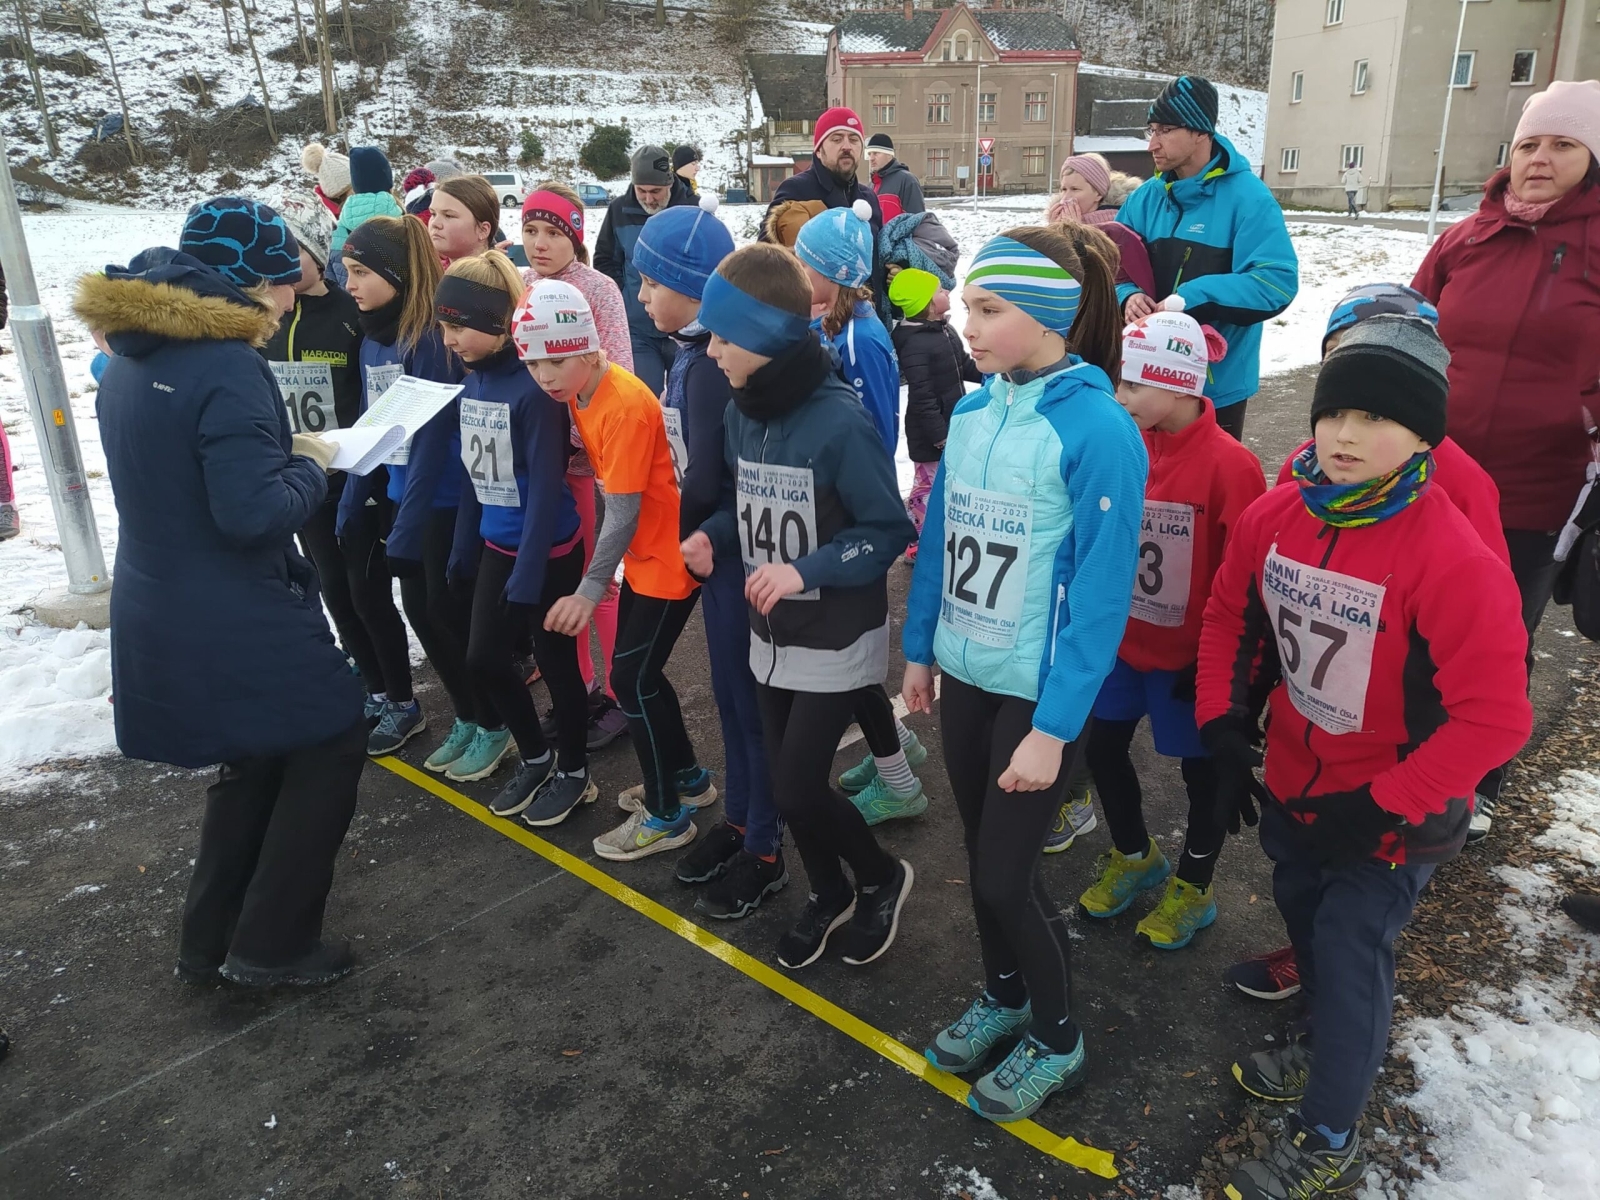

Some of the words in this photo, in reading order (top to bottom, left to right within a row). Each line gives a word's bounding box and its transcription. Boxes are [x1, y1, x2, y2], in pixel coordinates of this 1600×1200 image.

[539, 293, 569, 301] FROLEN
[555, 312, 578, 324] LES
[1156, 318, 1190, 329] FROLEN
[544, 336, 590, 350] MARATON
[1166, 338, 1193, 356] LES
[301, 349, 348, 360] MARATON
[304, 376, 328, 386] LIGA
[1142, 363, 1199, 383] MARATON
[285, 390, 326, 434] 16
[461, 414, 486, 428] BĚŽECKÁ
[490, 420, 508, 430] LIGA
[470, 434, 499, 482] 21
[738, 480, 777, 499] BĚŽECKÁ
[781, 488, 809, 502] LIGA
[947, 507, 985, 529] ĚŽECKÁ
[991, 517, 1026, 536] LIGA
[1159, 523, 1190, 537] LIGA
[741, 502, 809, 564] 140
[947, 531, 1018, 610] 127
[1312, 576, 1330, 586] KRÁLE
[1331, 580, 1364, 595] JESTŘEBÍCH
[1365, 590, 1378, 599] HOR
[1264, 571, 1322, 611] BĚŽECKÁ
[1330, 600, 1371, 628] LIGA
[1000, 616, 1016, 628] ČÍSLA
[1278, 604, 1348, 691] 57
[1307, 694, 1337, 714] STARTOVNÍ
[1339, 705, 1358, 721] ČÍSLA
